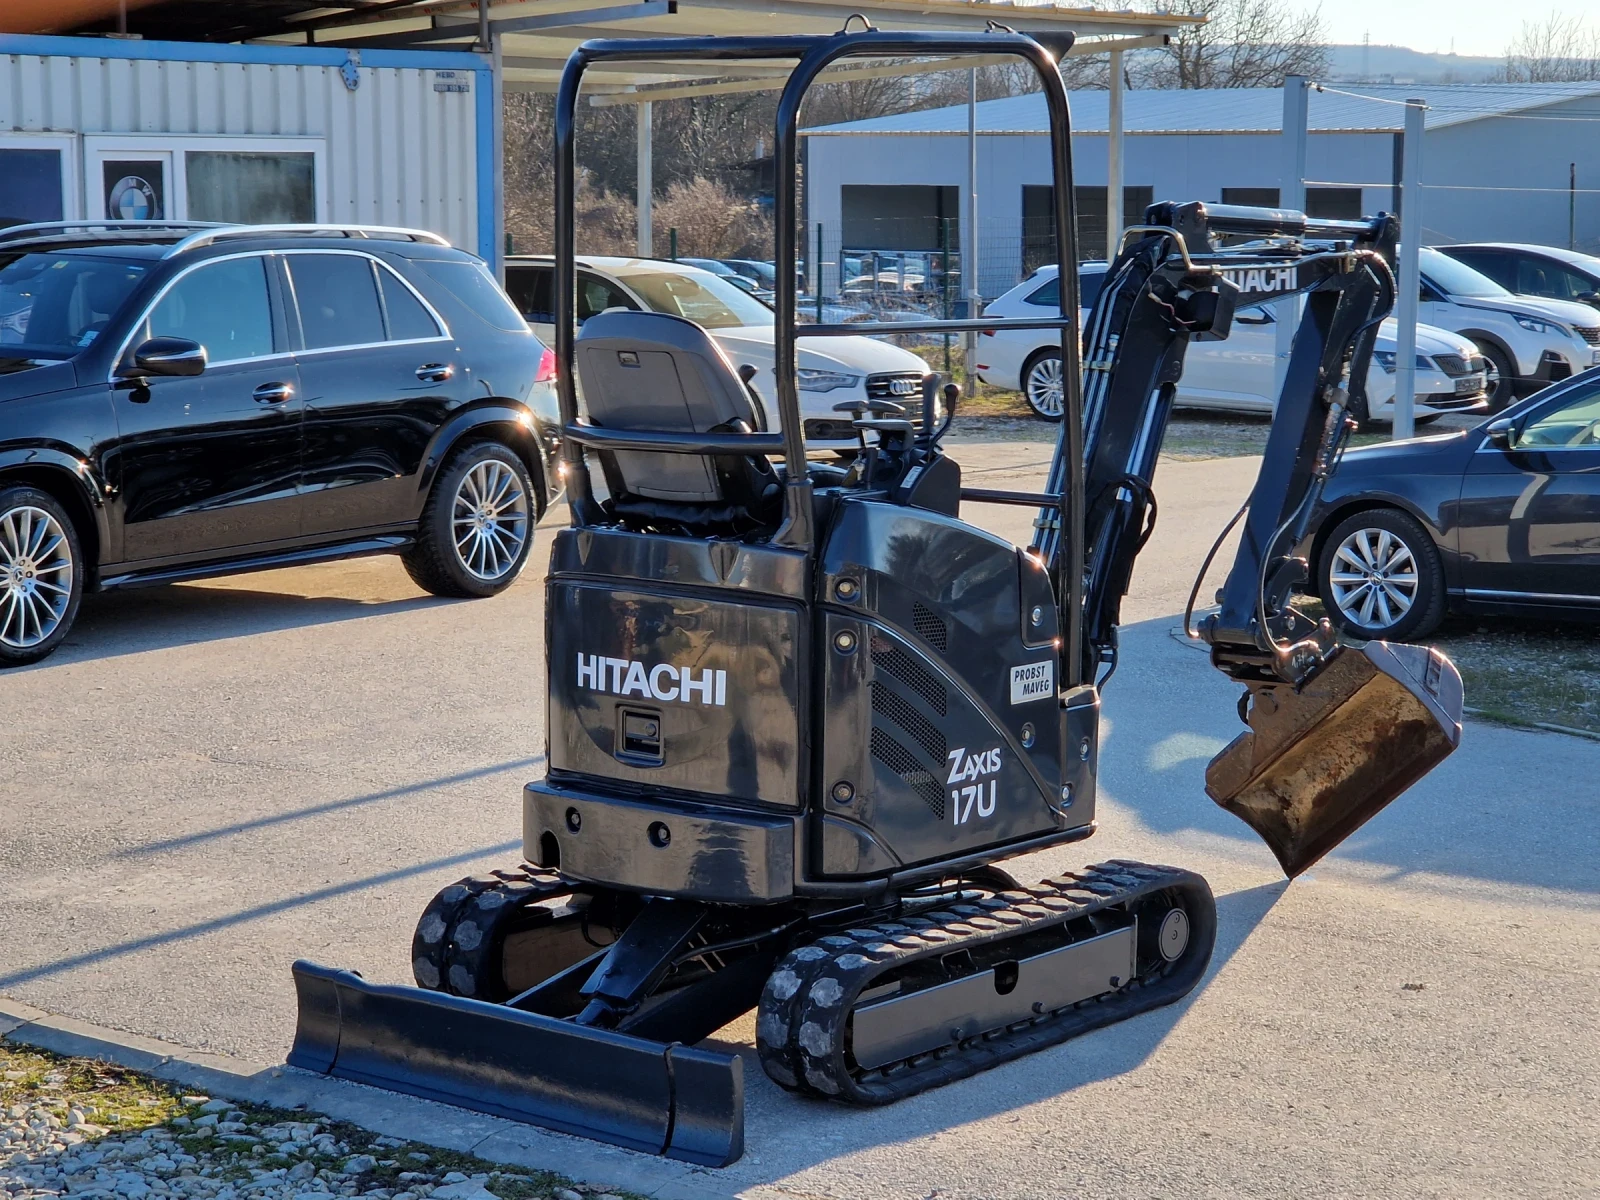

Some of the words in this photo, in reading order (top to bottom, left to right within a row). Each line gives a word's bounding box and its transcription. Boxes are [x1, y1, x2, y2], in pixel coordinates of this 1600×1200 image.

[1222, 267, 1297, 292] ITACHI
[577, 652, 726, 706] HITACHI
[1014, 665, 1046, 682] PROBST
[1022, 679, 1050, 696] MAVEG
[951, 779, 996, 826] 17U
